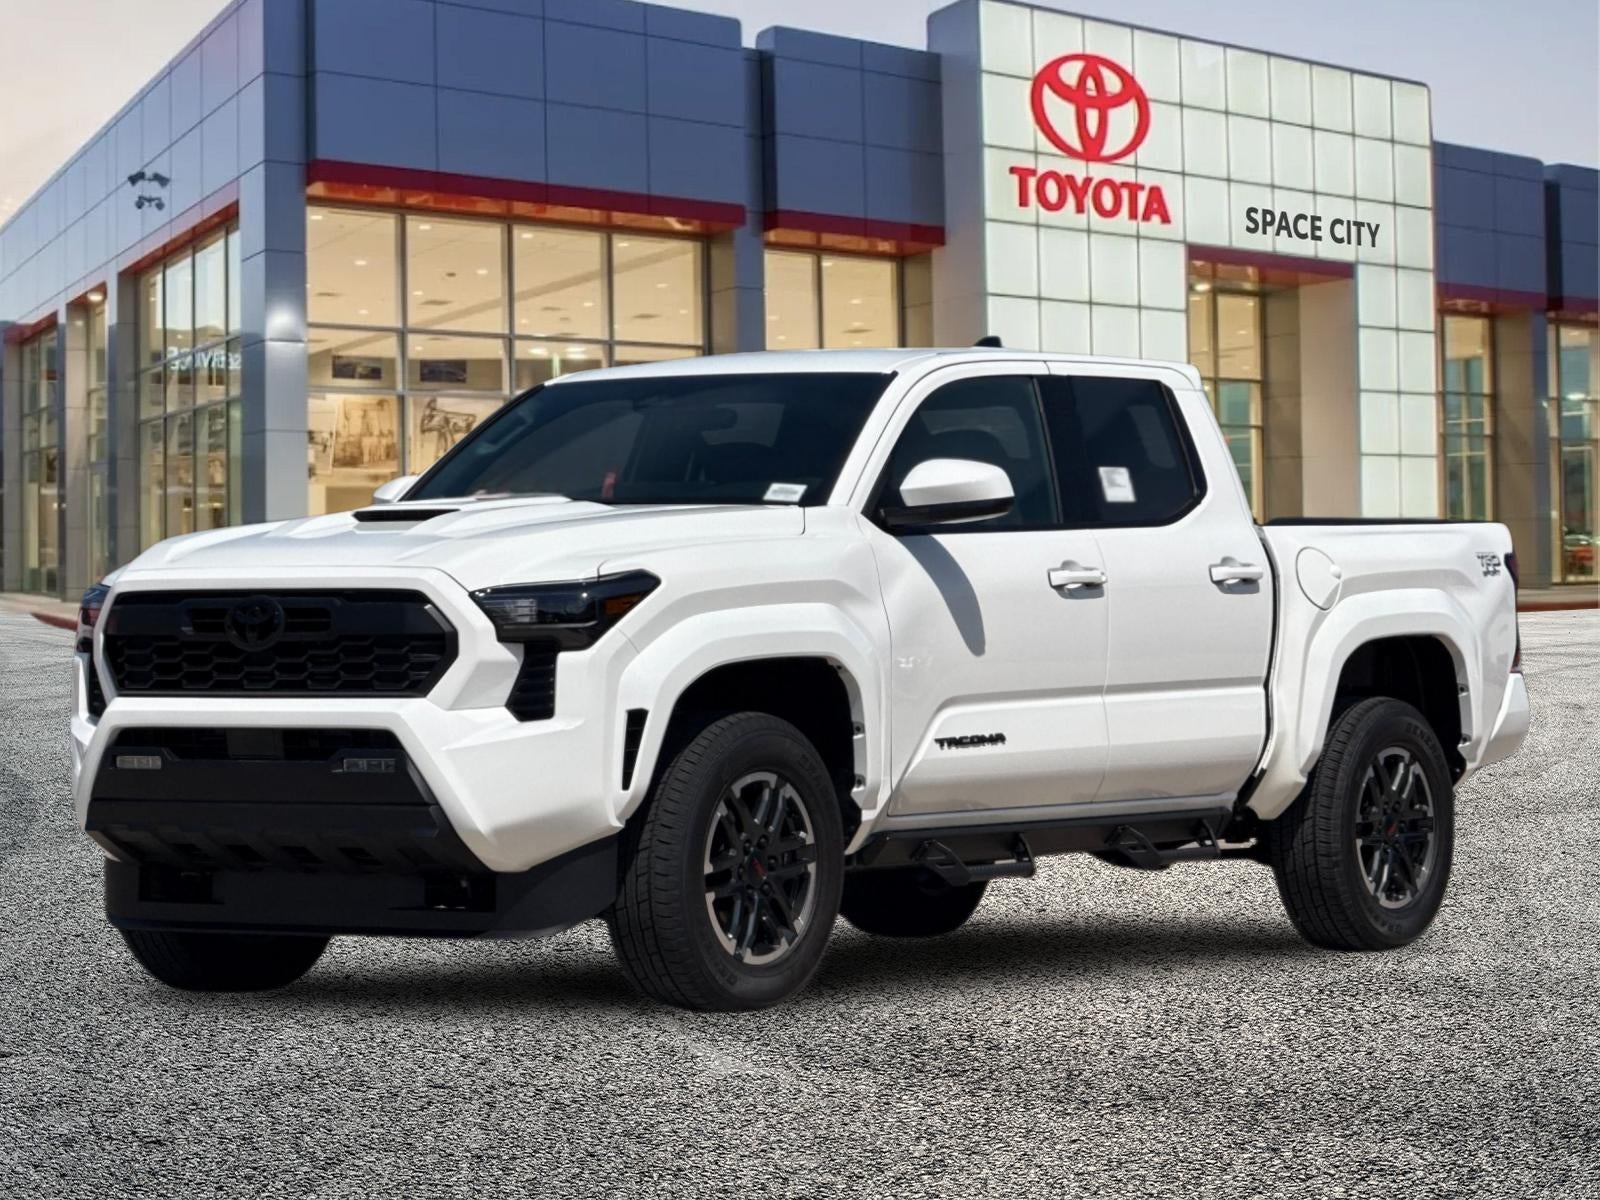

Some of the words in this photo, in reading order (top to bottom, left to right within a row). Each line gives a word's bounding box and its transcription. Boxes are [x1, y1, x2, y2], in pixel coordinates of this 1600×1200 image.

[1009, 166, 1171, 224] TOYOTA
[1245, 207, 1322, 242] SPACE
[1329, 217, 1381, 248] CITY
[934, 733, 1006, 750] TACOMA
